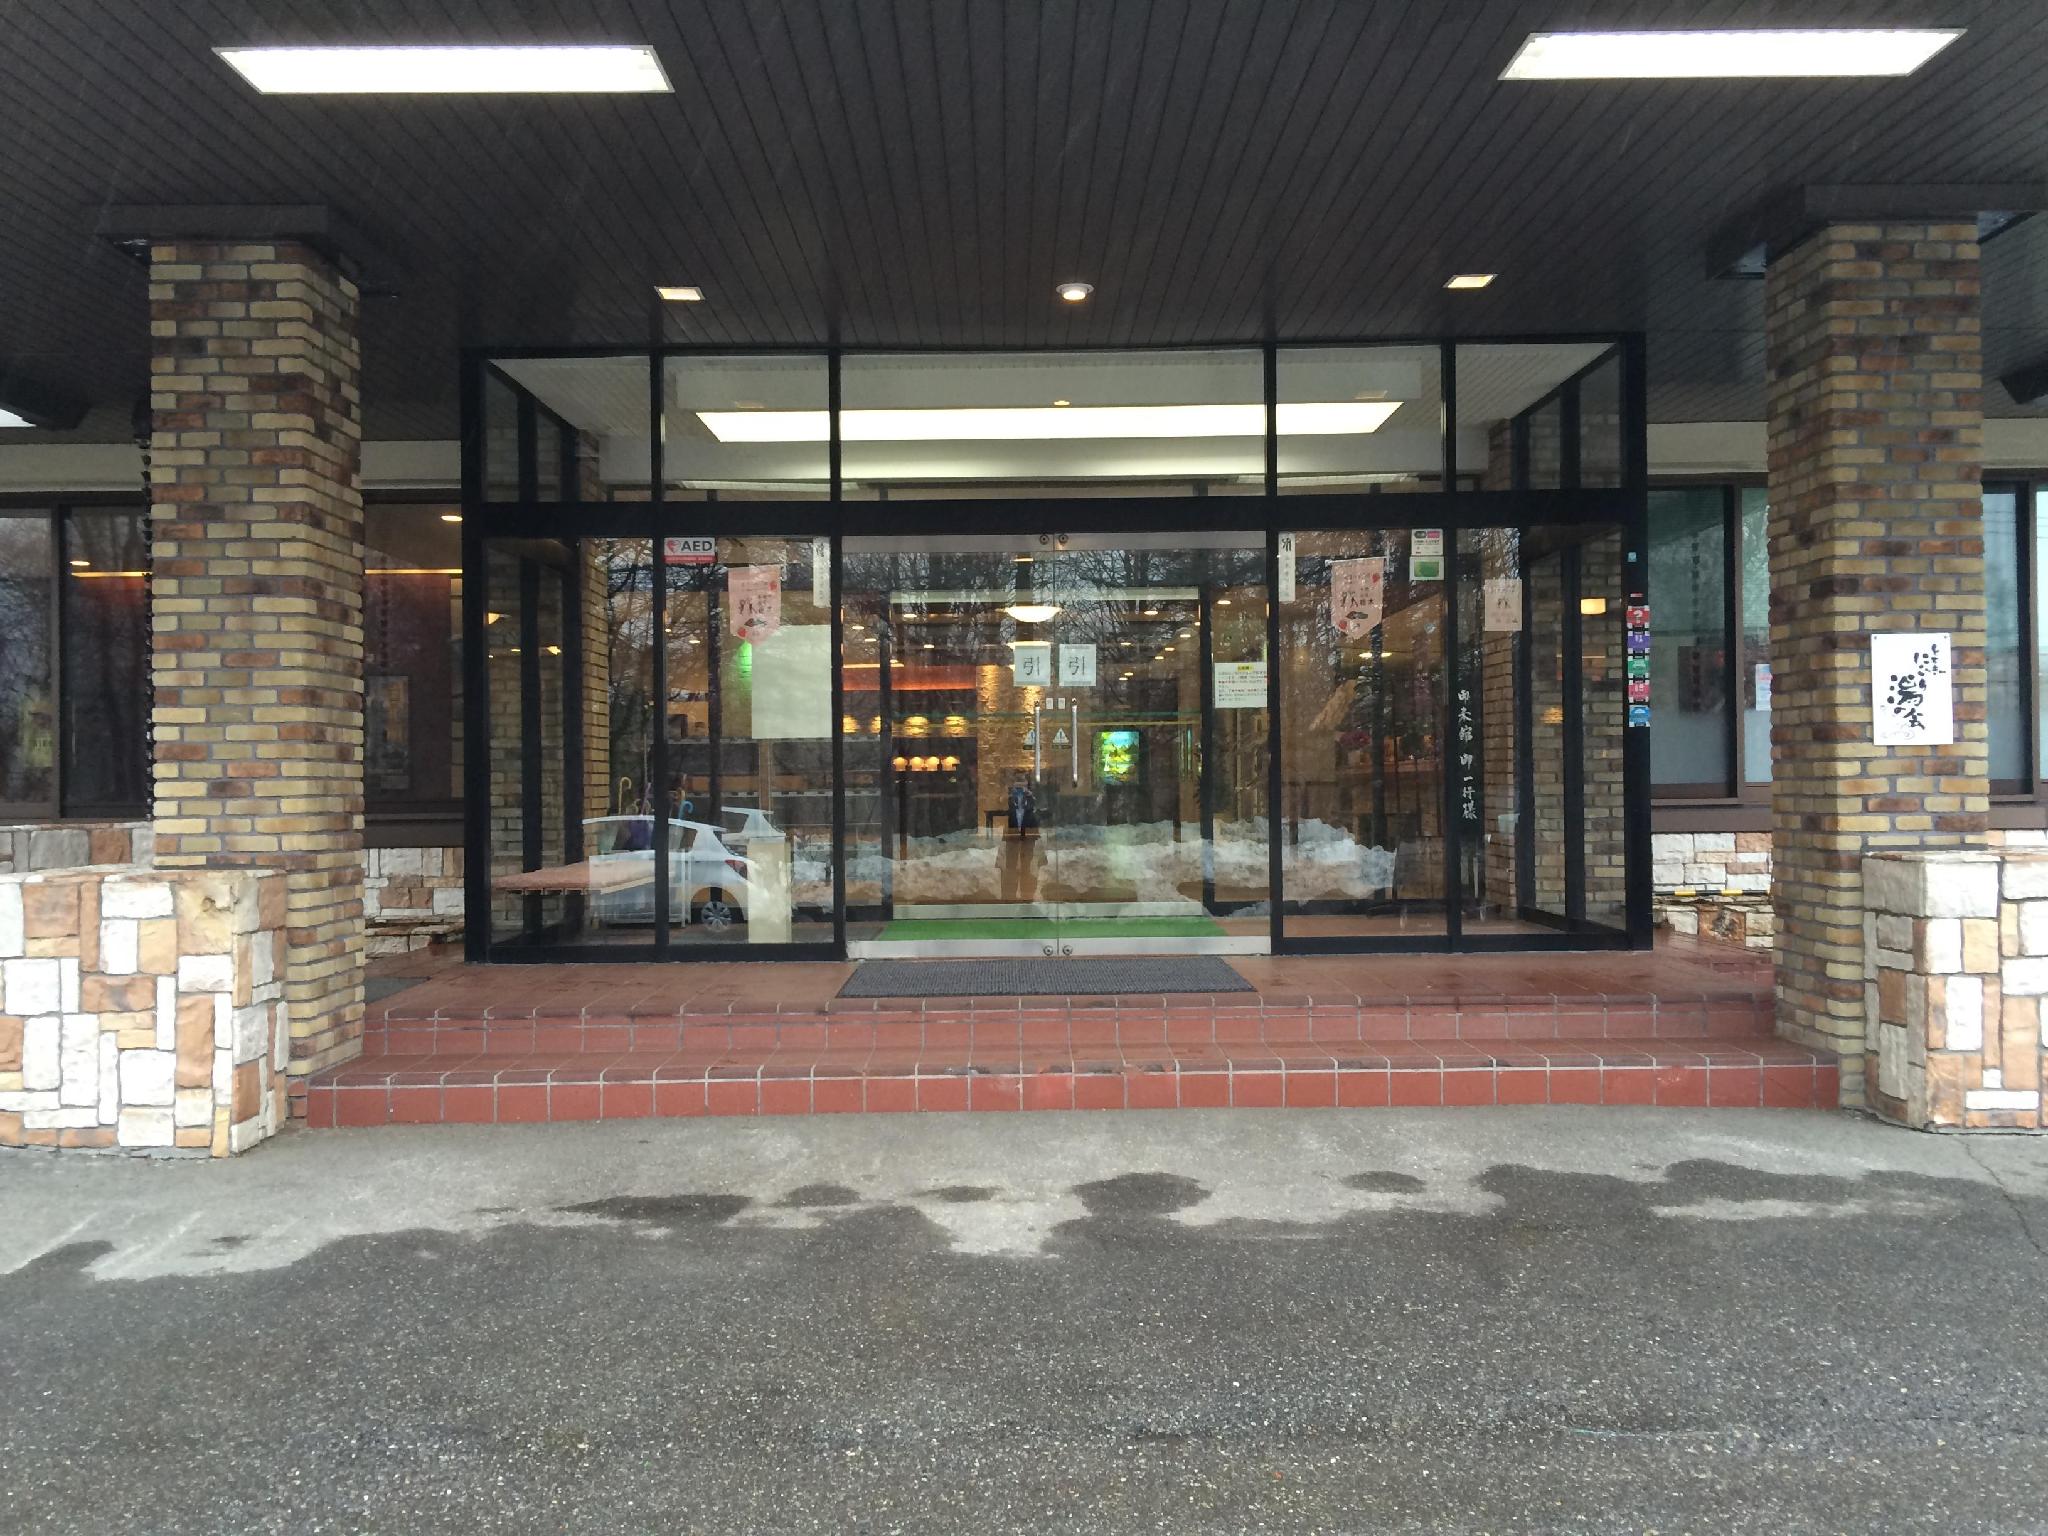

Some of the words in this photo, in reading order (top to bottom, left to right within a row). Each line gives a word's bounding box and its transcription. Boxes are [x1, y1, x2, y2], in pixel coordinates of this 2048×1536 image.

[681, 540, 712, 552] AED
[1023, 655, 1040, 676] 引
[1068, 655, 1085, 676] 引
